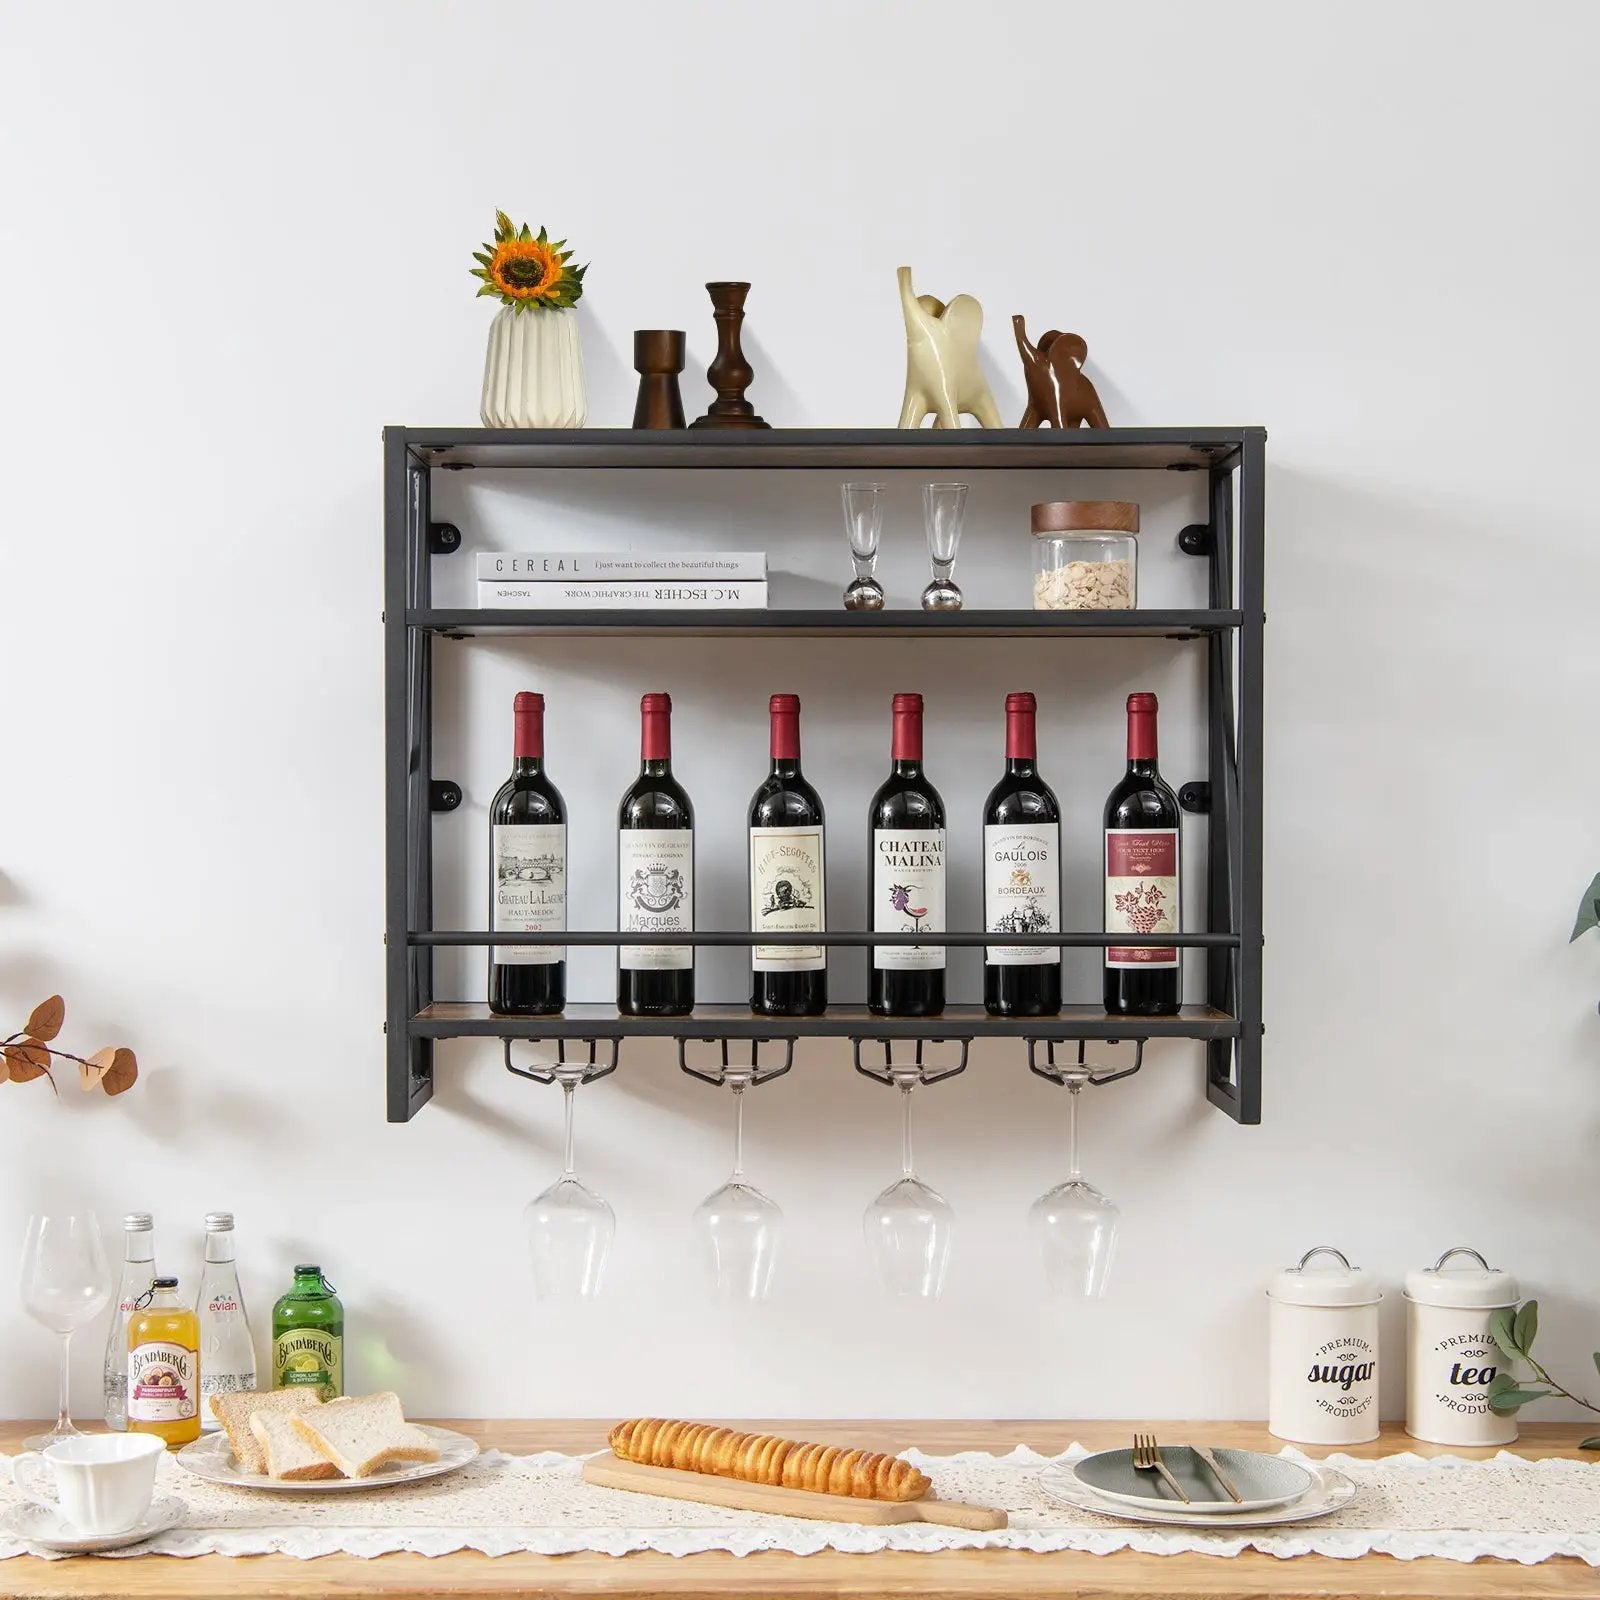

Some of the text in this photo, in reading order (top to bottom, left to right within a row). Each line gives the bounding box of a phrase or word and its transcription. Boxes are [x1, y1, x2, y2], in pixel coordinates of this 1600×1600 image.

[495, 559, 580, 572] CEREAL
[643, 561, 667, 569] collect
[668, 561, 680, 569] the
[681, 560, 715, 569] beautiful
[715, 561, 739, 570] things
[564, 590, 593, 598] WORK
[594, 590, 632, 598] GRAPHIC
[633, 590, 650, 598] THE
[654, 589, 707, 600] ESCHER
[879, 840, 944, 853] CHATEAU
[994, 850, 1048, 862] GAULOIS
[997, 886, 1045, 895] BORDEAUX
[629, 914, 680, 928] Marques
[209, 1301, 238, 1311] evian
[1319, 1338, 1370, 1355] PREMIUM
[1440, 1334, 1500, 1350] PREMIU
[1307, 1361, 1376, 1391] sugar
[1450, 1362, 1497, 1386] tea
[1319, 1396, 1371, 1418] PRODUCTS
[1440, 1395, 1493, 1414] PRODUC
